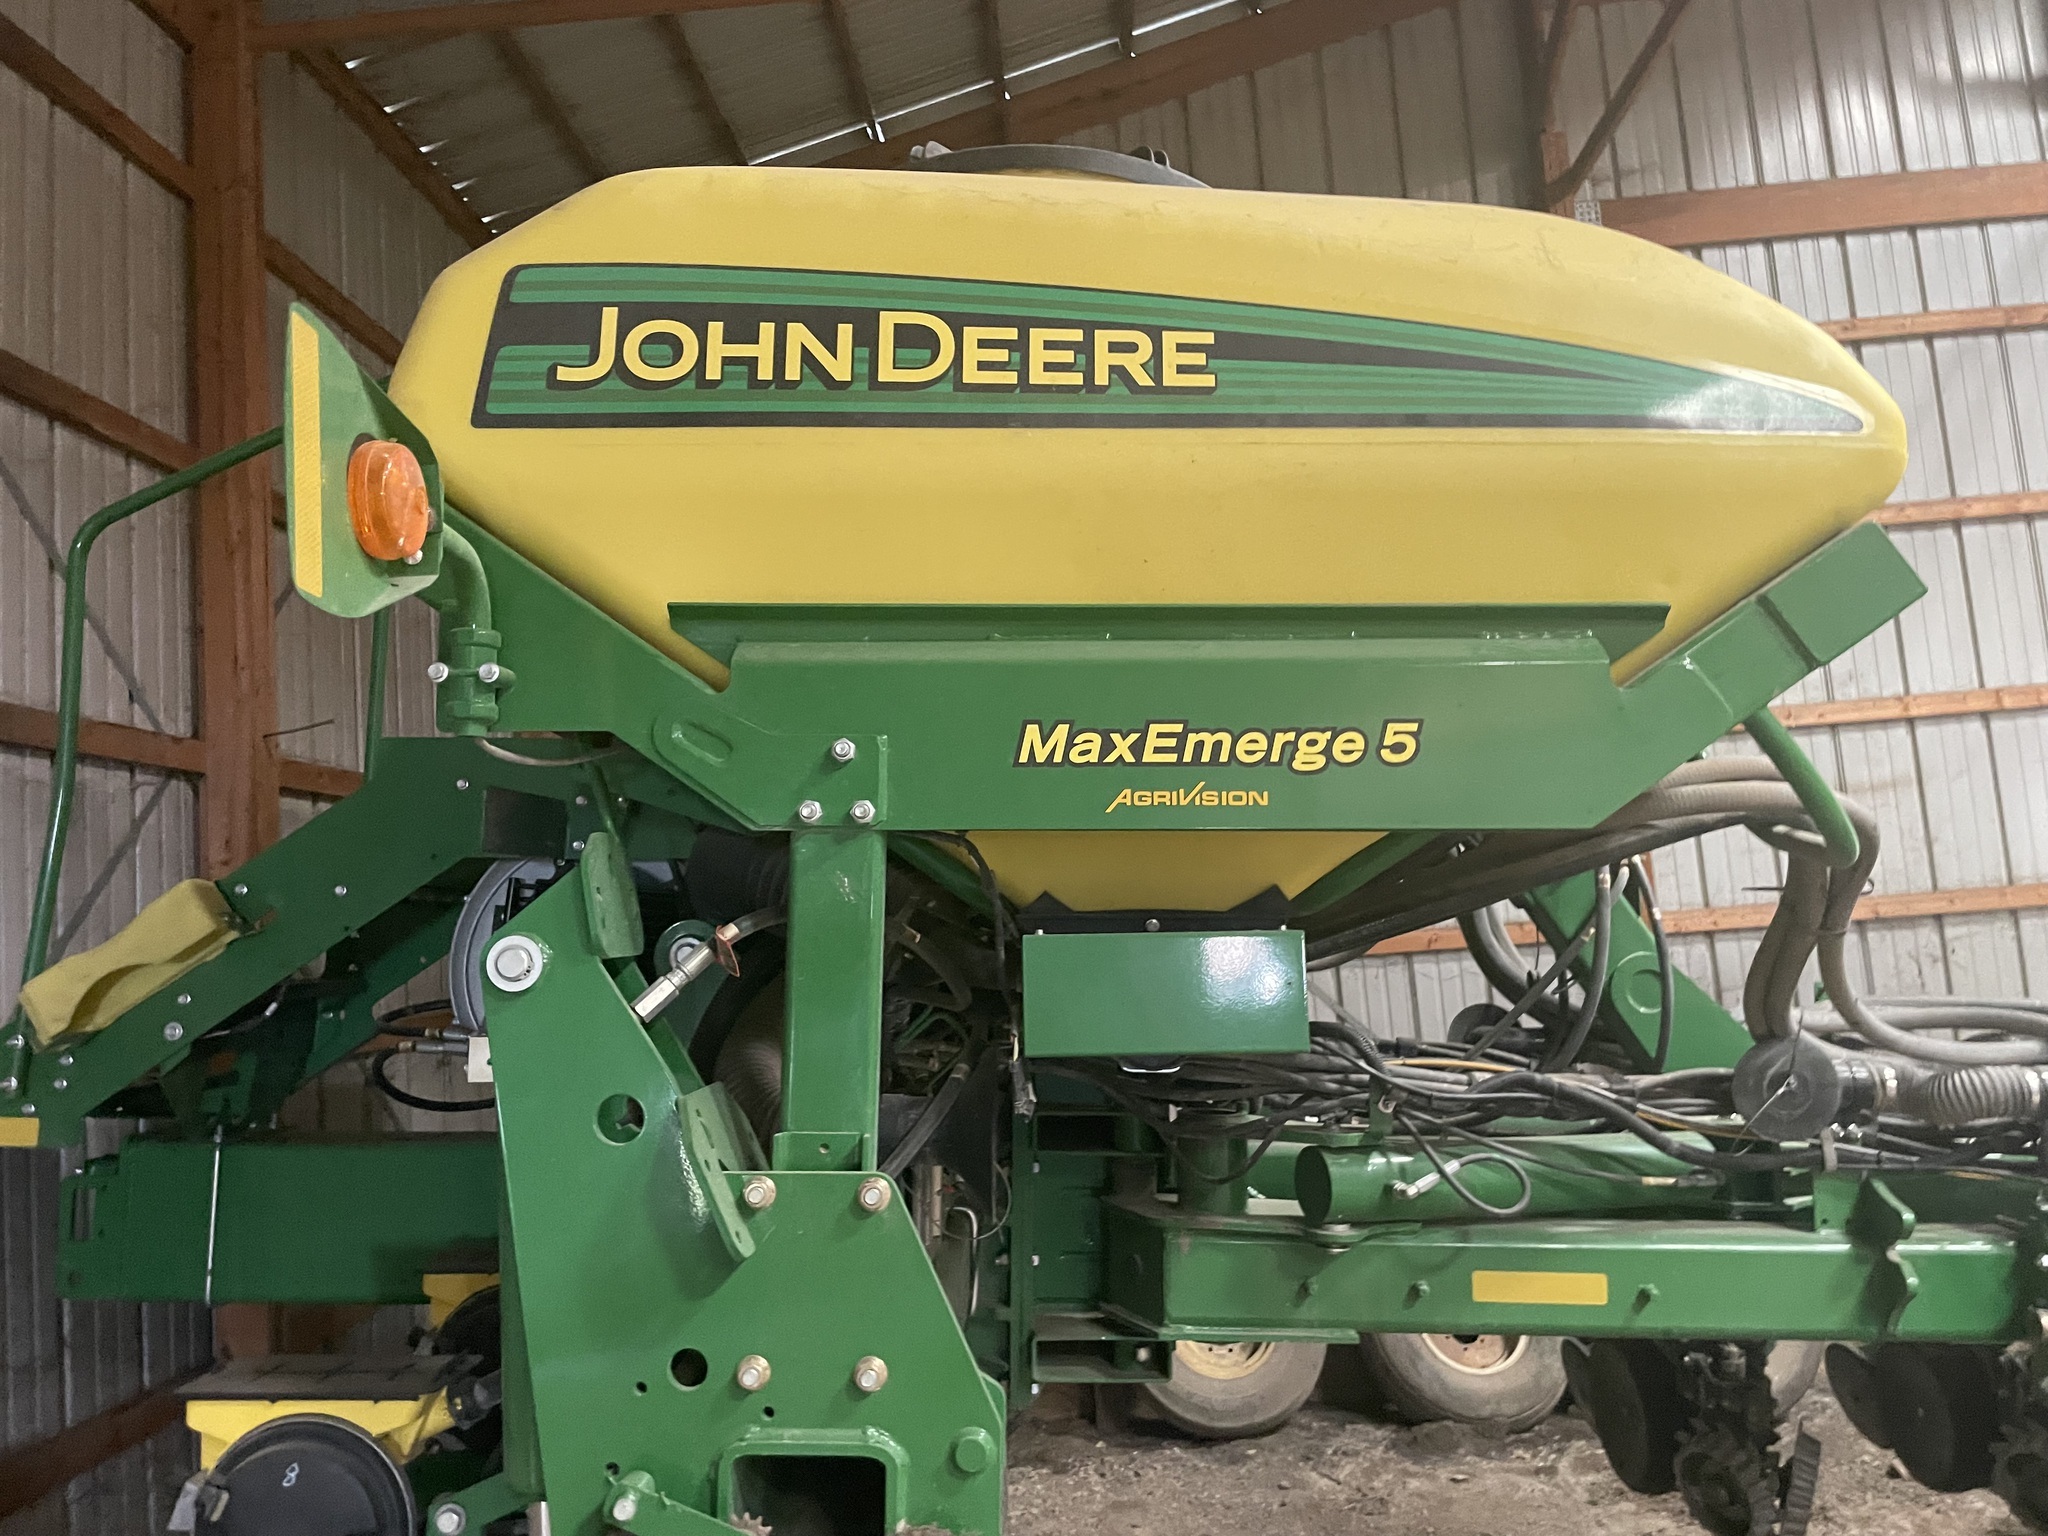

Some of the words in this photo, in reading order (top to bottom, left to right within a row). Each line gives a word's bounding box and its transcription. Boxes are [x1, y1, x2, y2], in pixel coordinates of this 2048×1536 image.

[555, 306, 854, 383] JOHN
[877, 310, 1217, 388] DEERE
[1017, 722, 1366, 772] MaxEmerge
[1379, 722, 1420, 764] 5
[282, 1462, 300, 1487] 8
